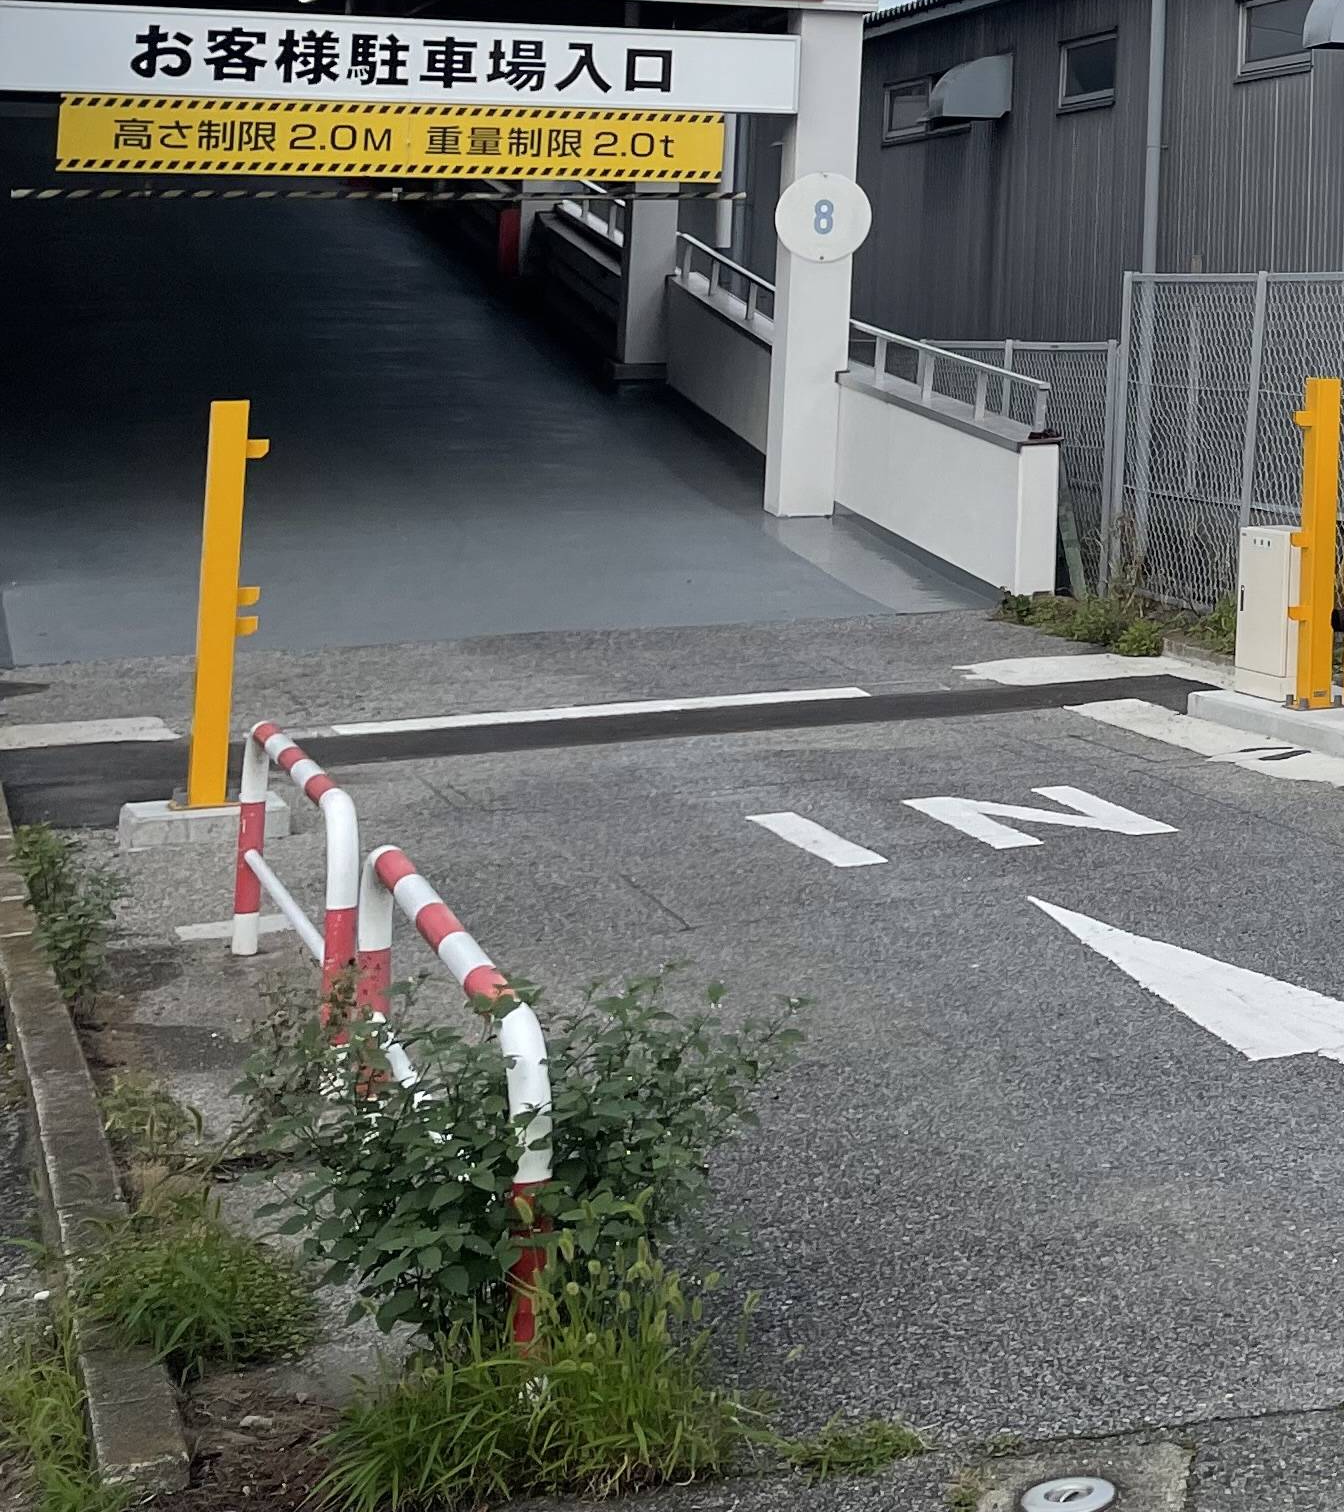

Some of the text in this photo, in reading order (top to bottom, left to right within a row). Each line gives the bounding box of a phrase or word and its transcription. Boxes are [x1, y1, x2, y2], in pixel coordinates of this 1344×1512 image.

[130, 23, 674, 94] お客様駐車場入口
[112, 118, 676, 160] 高さ制限 2.0M 重量制限 2.0t
[812, 200, 834, 235] 8
[747, 785, 1180, 867] IN
